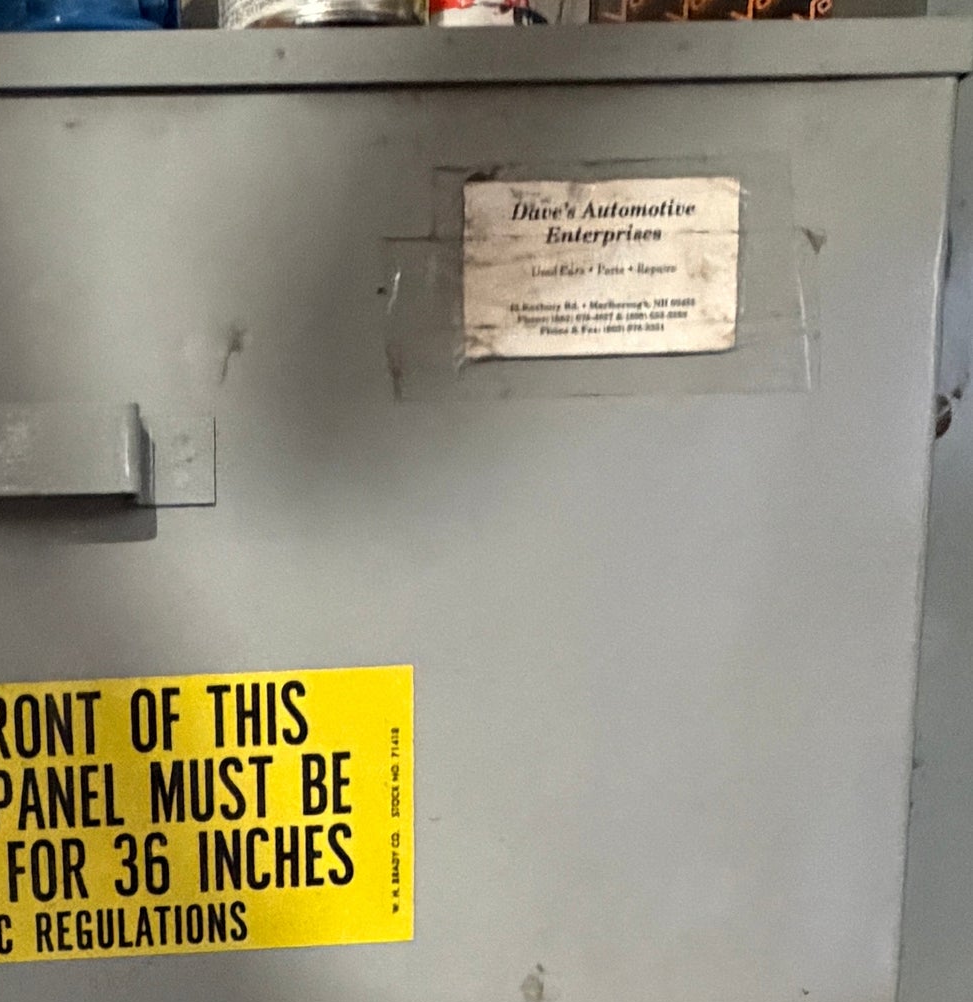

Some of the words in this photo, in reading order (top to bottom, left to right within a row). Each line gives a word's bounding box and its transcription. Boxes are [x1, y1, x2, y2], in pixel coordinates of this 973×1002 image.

[511, 200, 576, 221] Dave's
[581, 198, 696, 219] Automotive
[546, 224, 662, 247] Enterprises
[130, 687, 180, 753] OF
[207, 680, 309, 748] THIS
[150, 756, 273, 824] MUST
[301, 751, 352, 816] BE
[390, 785, 400, 818] STOCK
[390, 830, 400, 849] CO.
[6, 838, 89, 904] FOR
[113, 832, 171, 897] 36
[199, 823, 355, 893] INCHES
[391, 850, 400, 885] BRADY
[36, 901, 249, 953] REGULATIONS
